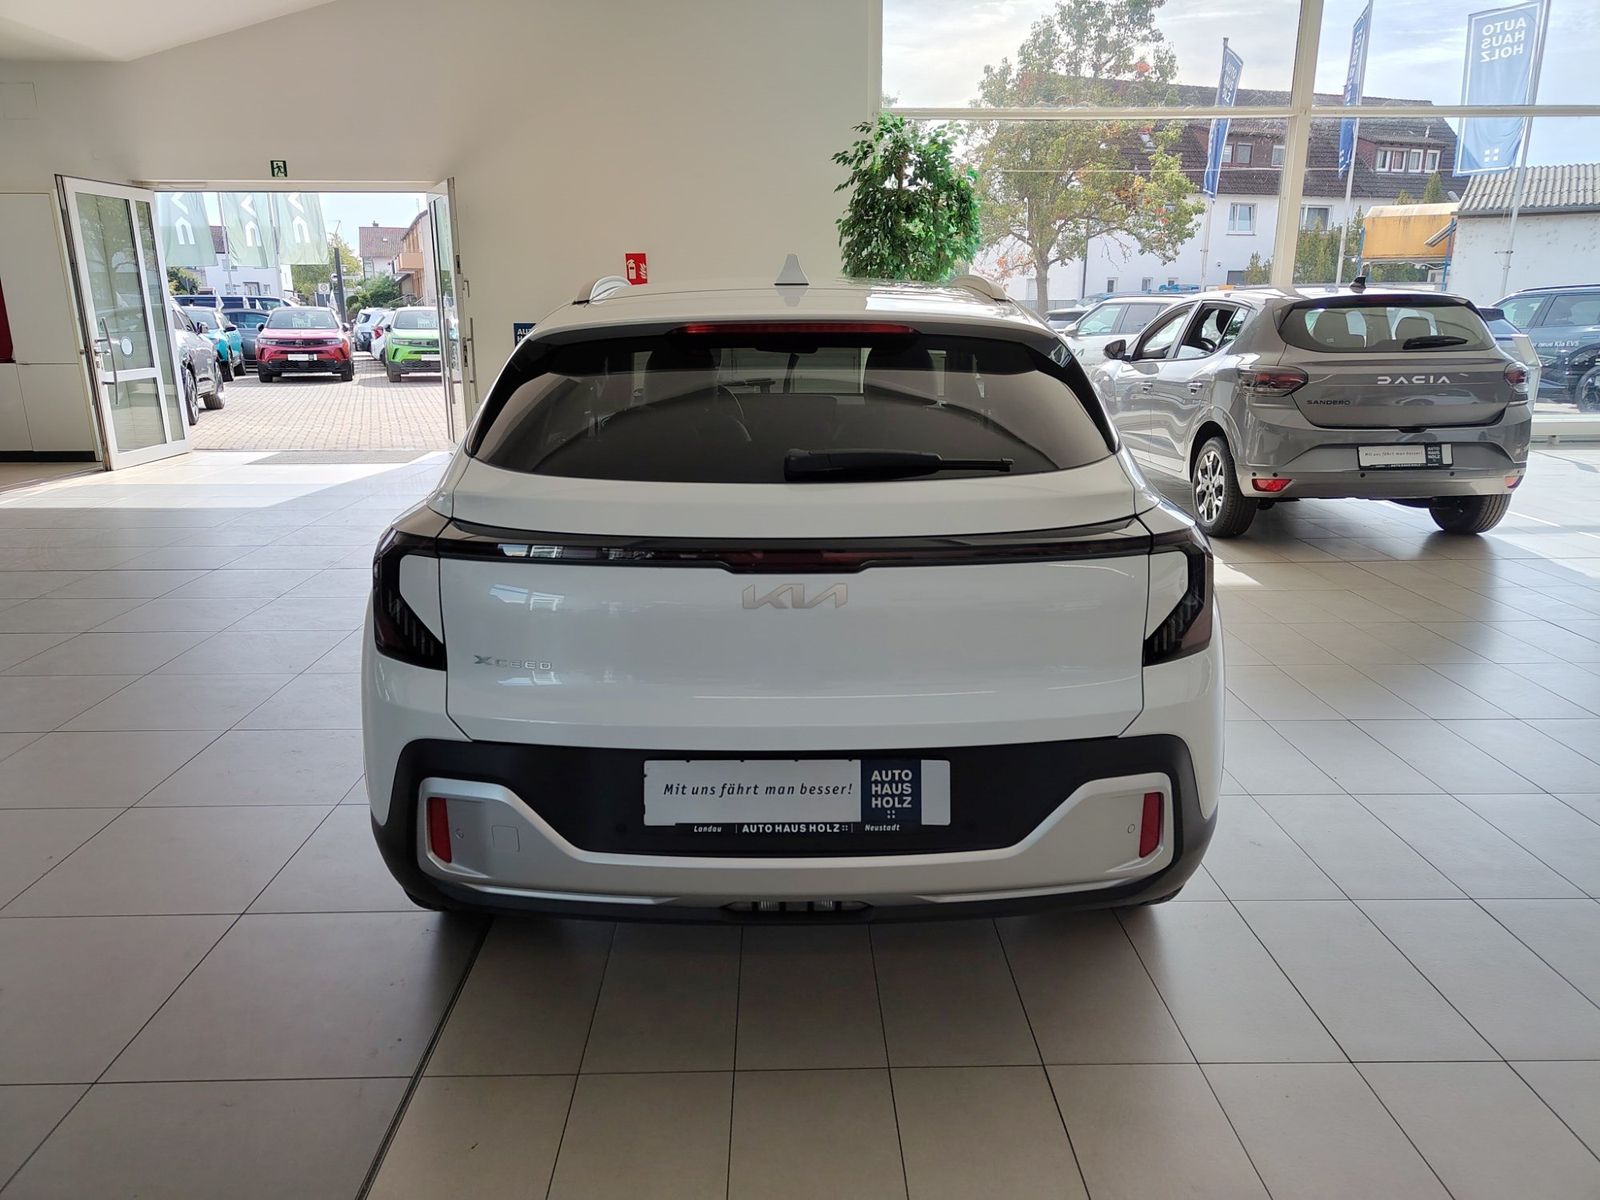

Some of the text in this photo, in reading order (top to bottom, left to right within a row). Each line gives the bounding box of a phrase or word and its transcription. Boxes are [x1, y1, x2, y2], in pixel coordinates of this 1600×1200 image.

[1377, 375, 1451, 385] DACIA
[742, 583, 849, 609] KIA
[871, 769, 913, 781] AUTO
[663, 783, 853, 798] Mit uns fährt man besser!
[871, 782, 913, 795] HAUS
[871, 796, 913, 808] HOLZ
[693, 825, 722, 833] Landau
[809, 823, 840, 832] HOLZ
[865, 824, 900, 832] Neustadt
